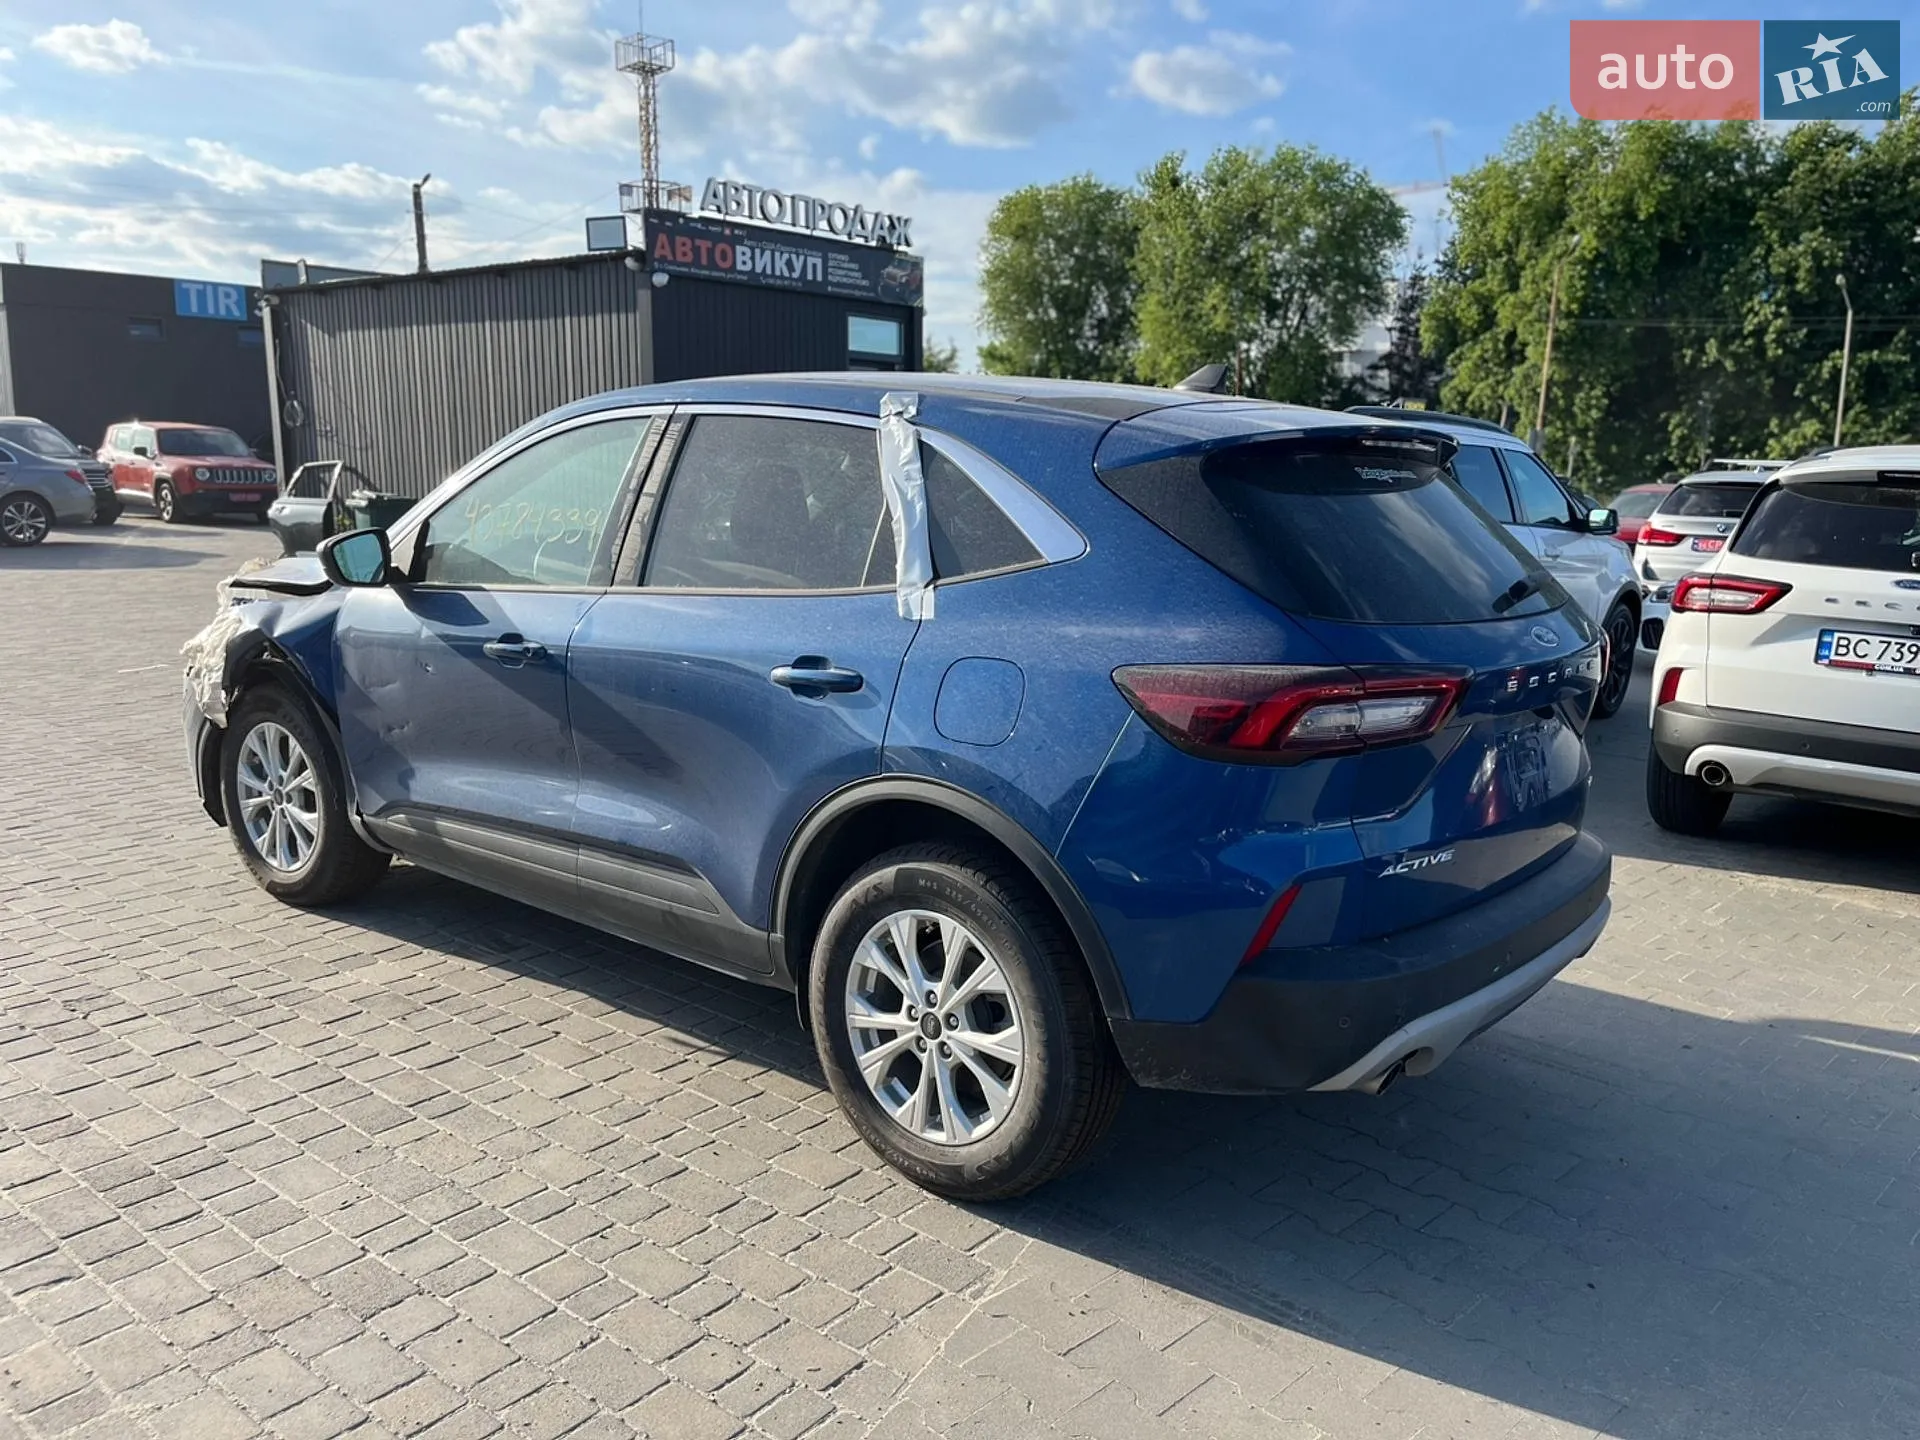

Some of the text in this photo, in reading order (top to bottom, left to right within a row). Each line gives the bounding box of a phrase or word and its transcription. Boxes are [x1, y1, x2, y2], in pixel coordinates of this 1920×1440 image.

[700, 176, 914, 248] АВТОПРОДАЖ
[654, 232, 823, 283] АВТОВИКУП
[181, 282, 241, 317] TIR
[1834, 636, 1871, 659] BC
[1378, 848, 1456, 879] ACTIVE
